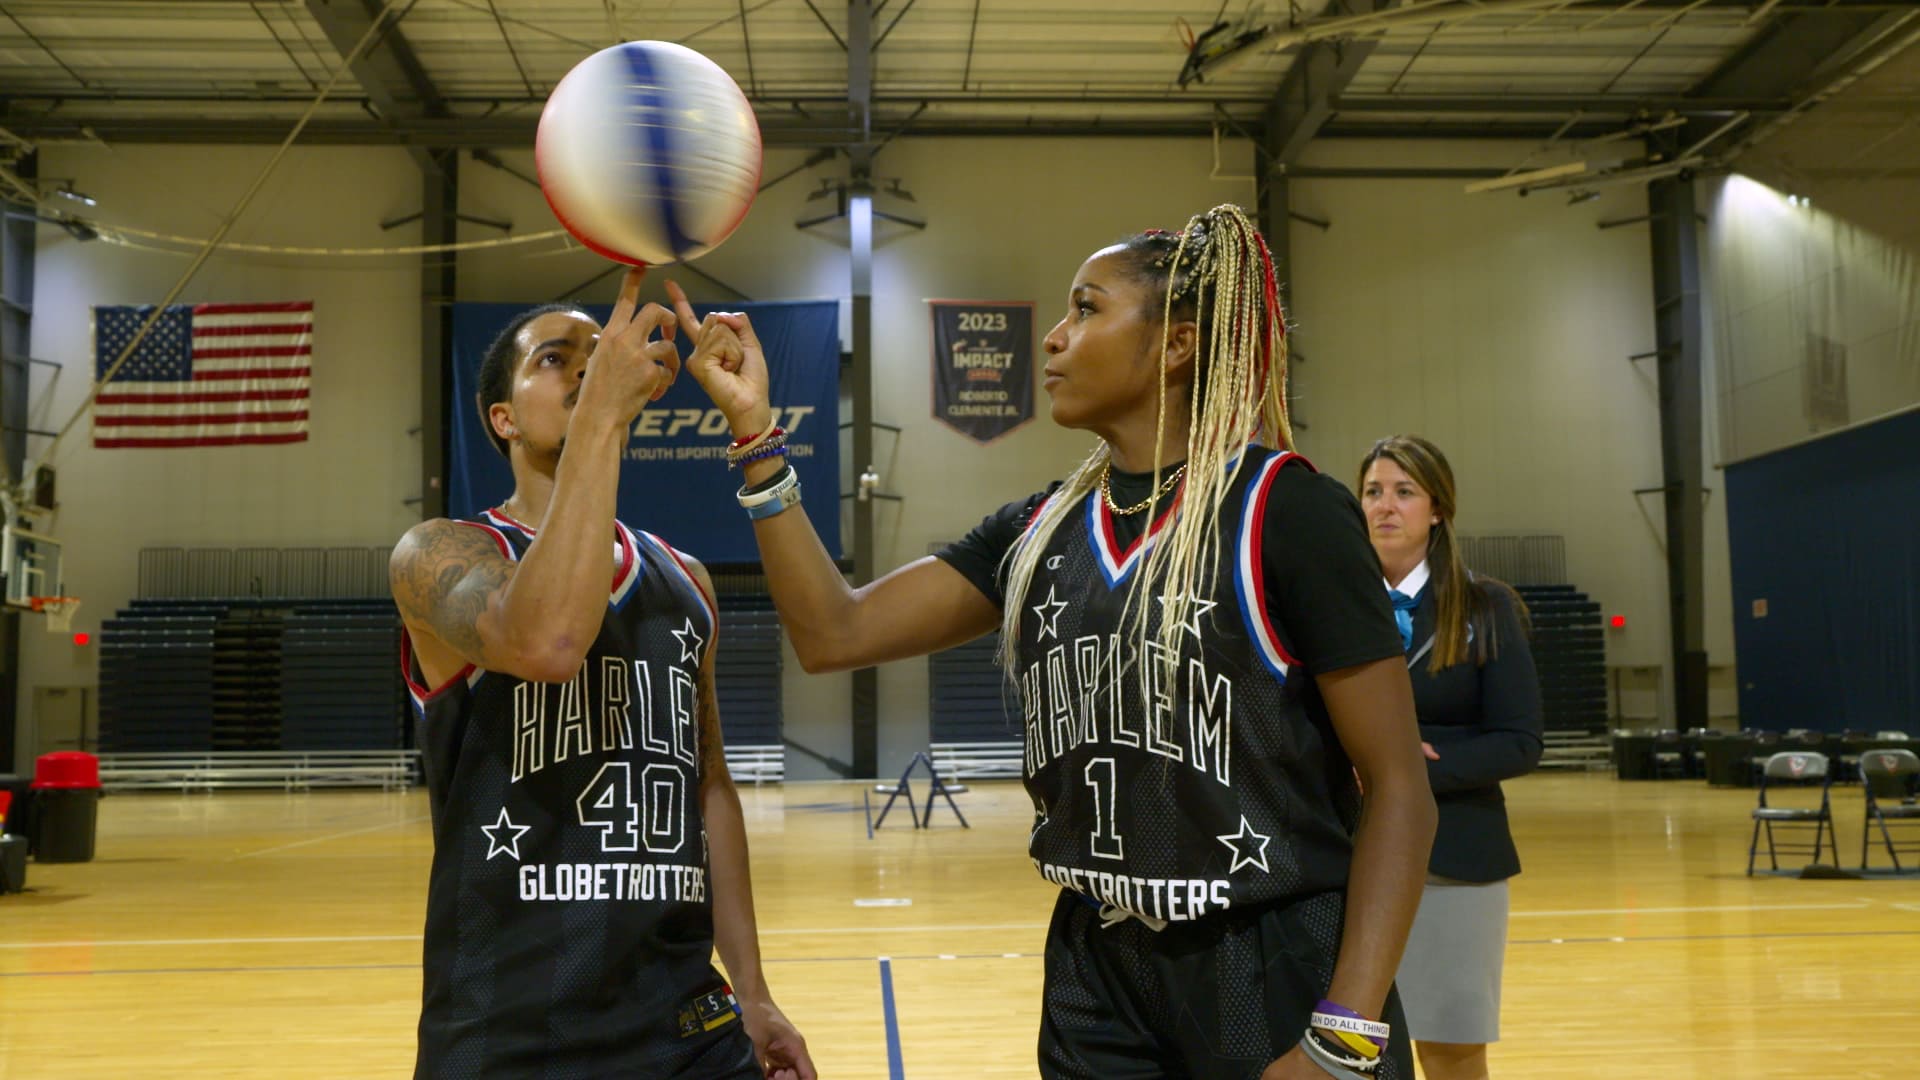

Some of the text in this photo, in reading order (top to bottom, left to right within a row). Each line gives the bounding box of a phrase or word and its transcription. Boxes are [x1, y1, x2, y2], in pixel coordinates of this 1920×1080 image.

[958, 312, 1008, 331] 2023
[953, 352, 1013, 368] IMPACT
[631, 448, 673, 460] YOUTH
[676, 447, 727, 460] SPORTS
[511, 655, 700, 784] HARLE
[1023, 633, 1231, 789] HARLEM
[576, 761, 688, 853] 40
[1084, 757, 1124, 860] 1
[519, 862, 705, 903] GLOBETROTTERS
[1324, 1017, 1337, 1027] DO
[1340, 1019, 1359, 1031] ALL
